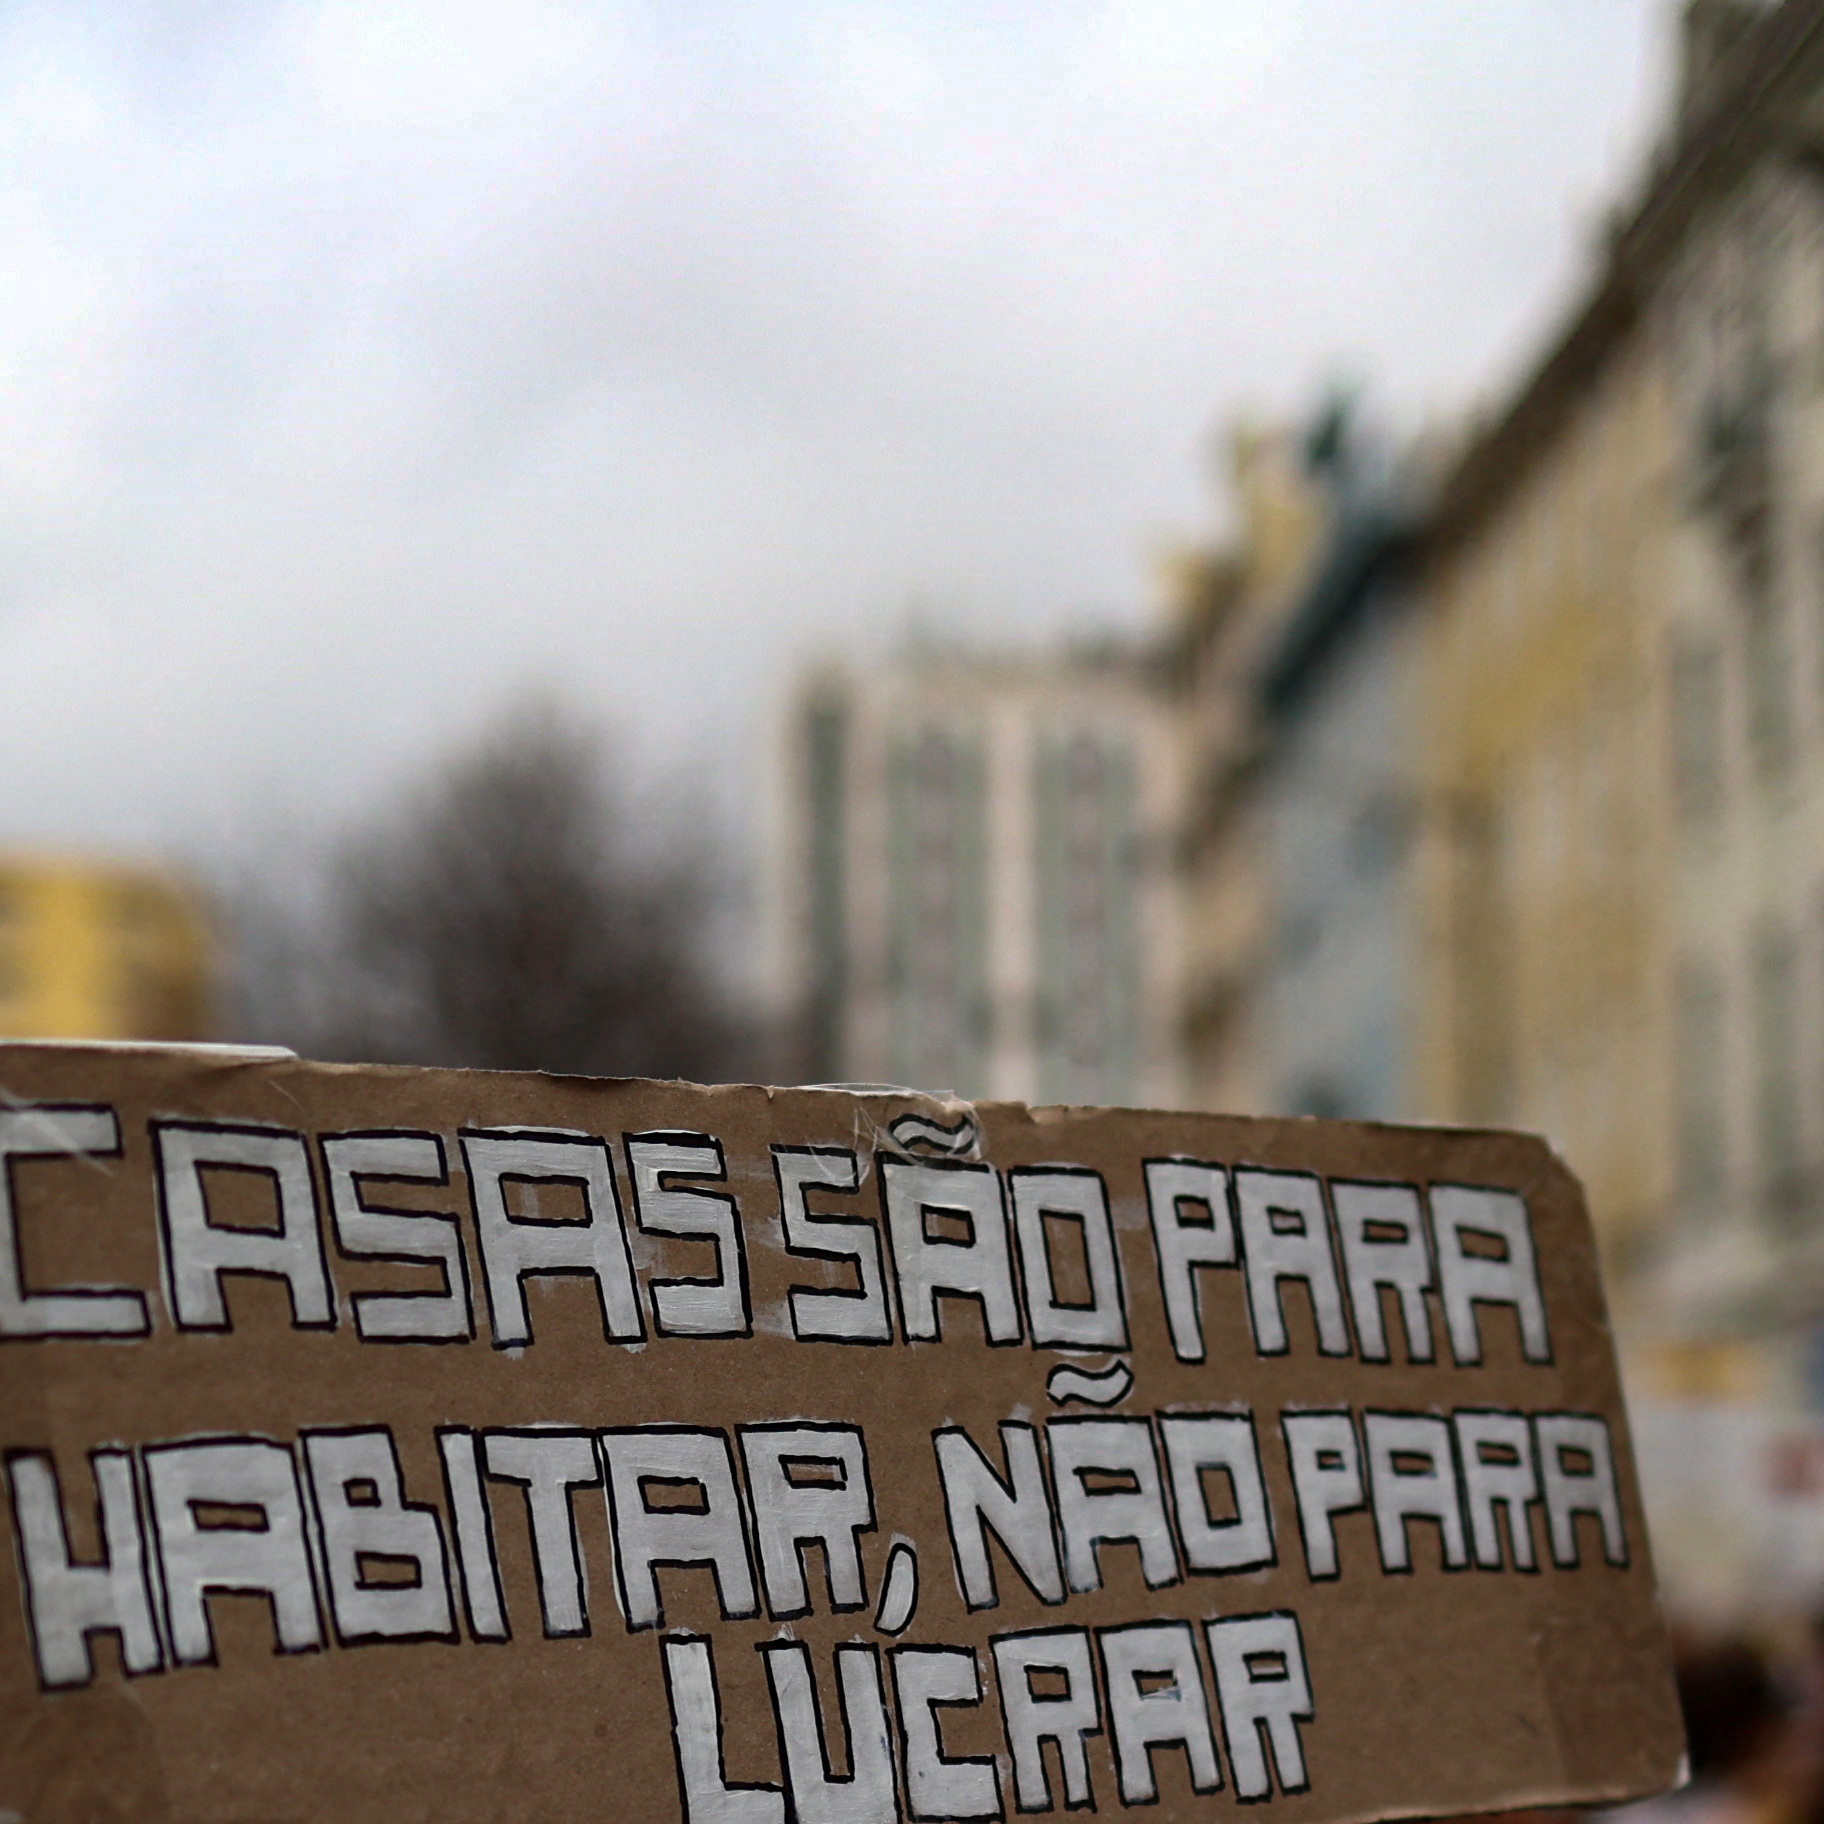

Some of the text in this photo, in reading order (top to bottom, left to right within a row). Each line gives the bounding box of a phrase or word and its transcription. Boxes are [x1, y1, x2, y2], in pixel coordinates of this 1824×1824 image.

[772, 1112, 1132, 1351] SÃO
[1143, 1157, 1553, 1366] PARA
[4, 1360, 1630, 1693] HABITAR, NÃO PARA
